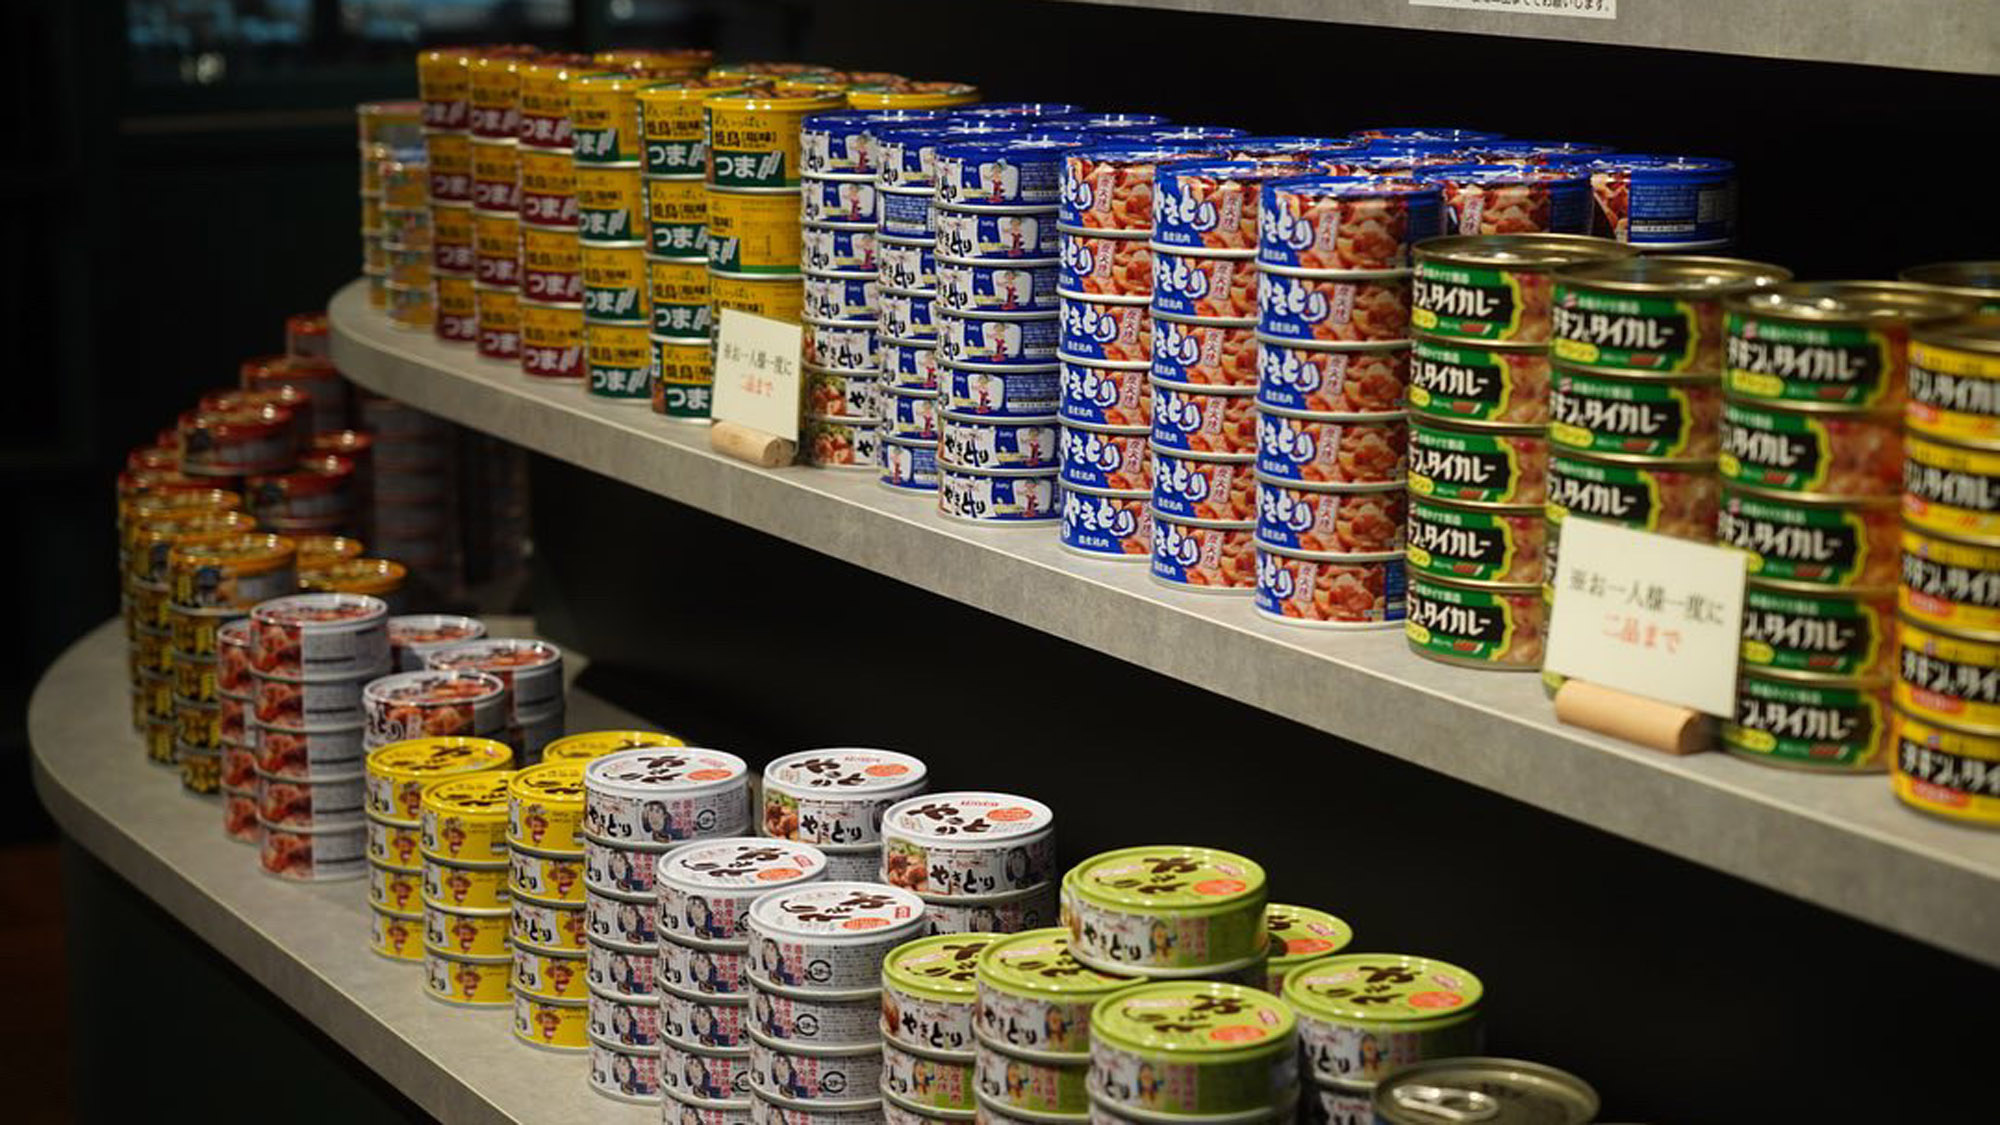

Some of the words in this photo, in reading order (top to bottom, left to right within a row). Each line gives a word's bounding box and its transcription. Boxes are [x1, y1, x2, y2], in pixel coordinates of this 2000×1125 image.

[1063, 490, 1135, 536] やきとり
[801, 813, 863, 843] やきとり
[930, 862, 996, 895] やきとり
[901, 1010, 964, 1049] やきとり
